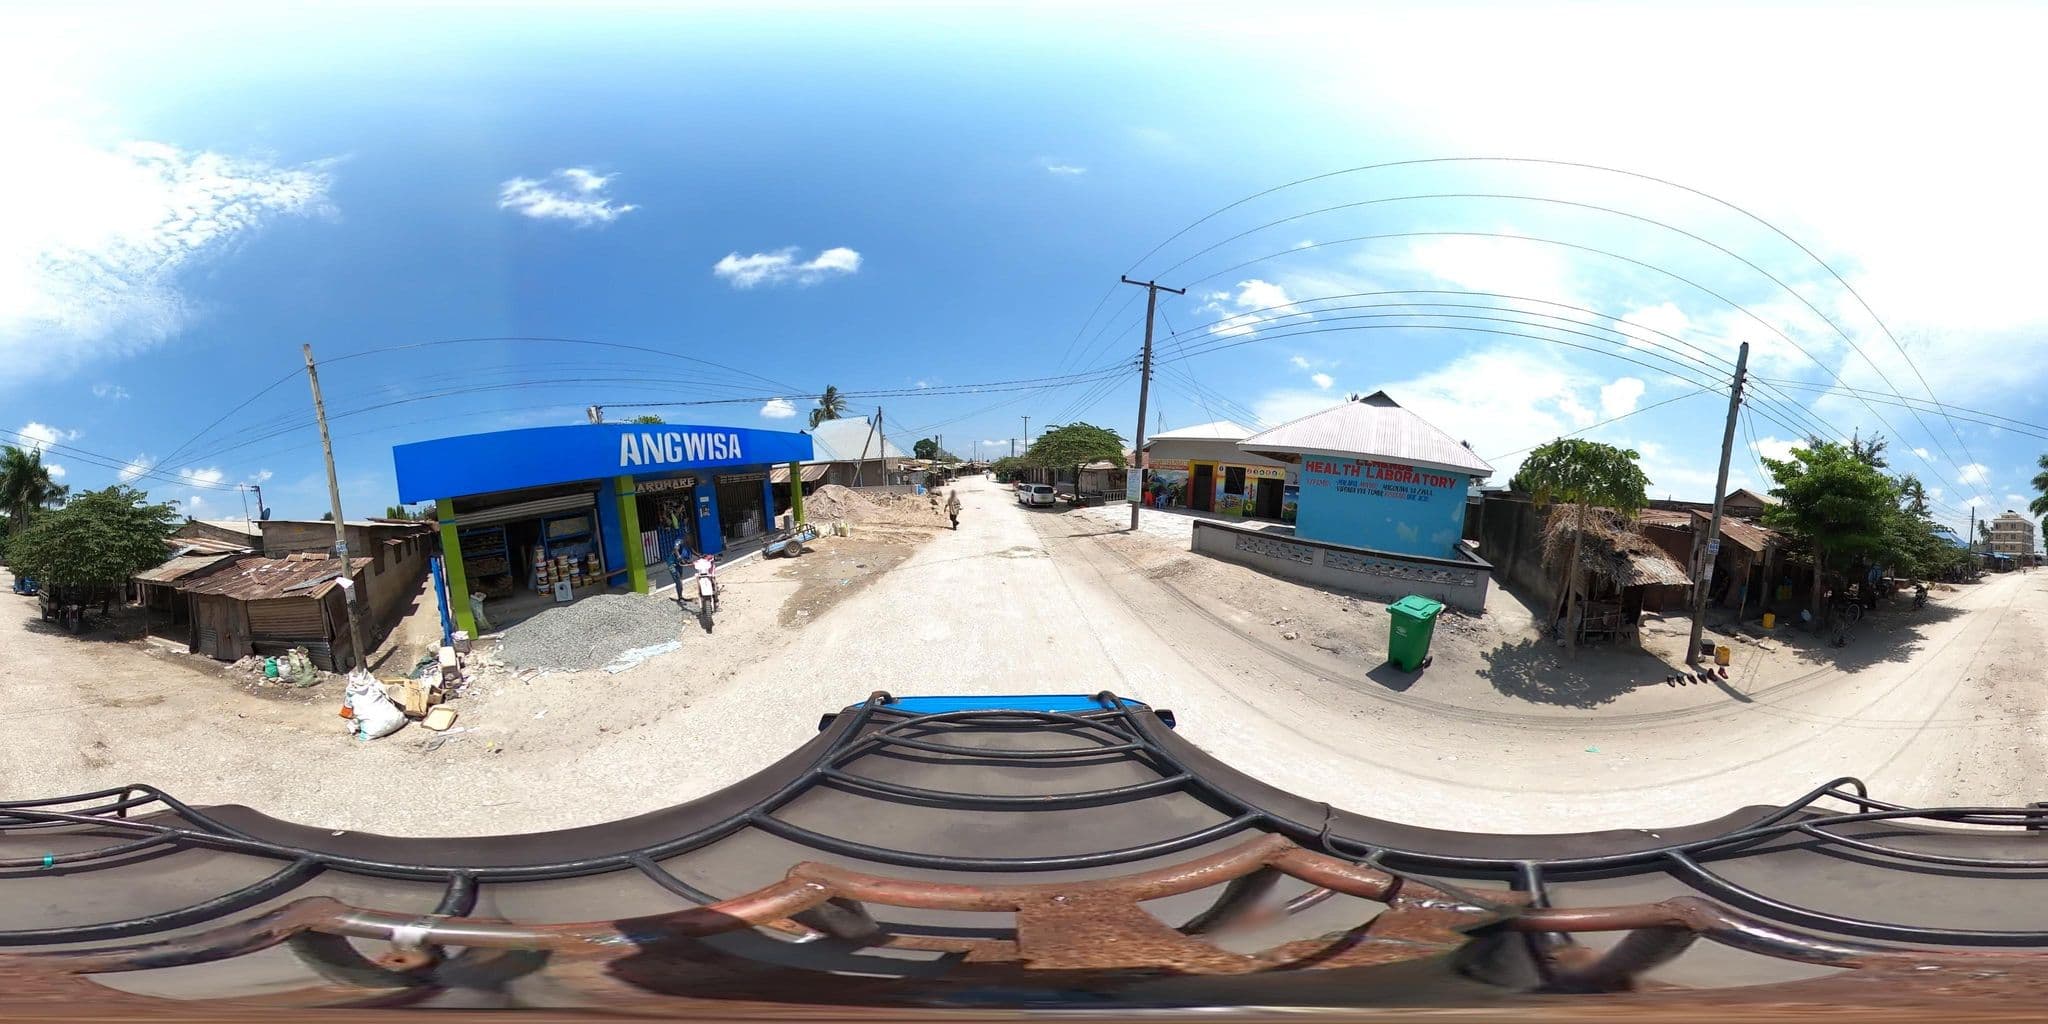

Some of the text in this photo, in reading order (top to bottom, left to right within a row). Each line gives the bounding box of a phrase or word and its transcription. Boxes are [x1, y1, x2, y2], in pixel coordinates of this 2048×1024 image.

[620, 432, 742, 467] ANGWISA
[1305, 461, 1360, 477] HEALTH
[1366, 466, 1457, 489] LABORATORY
